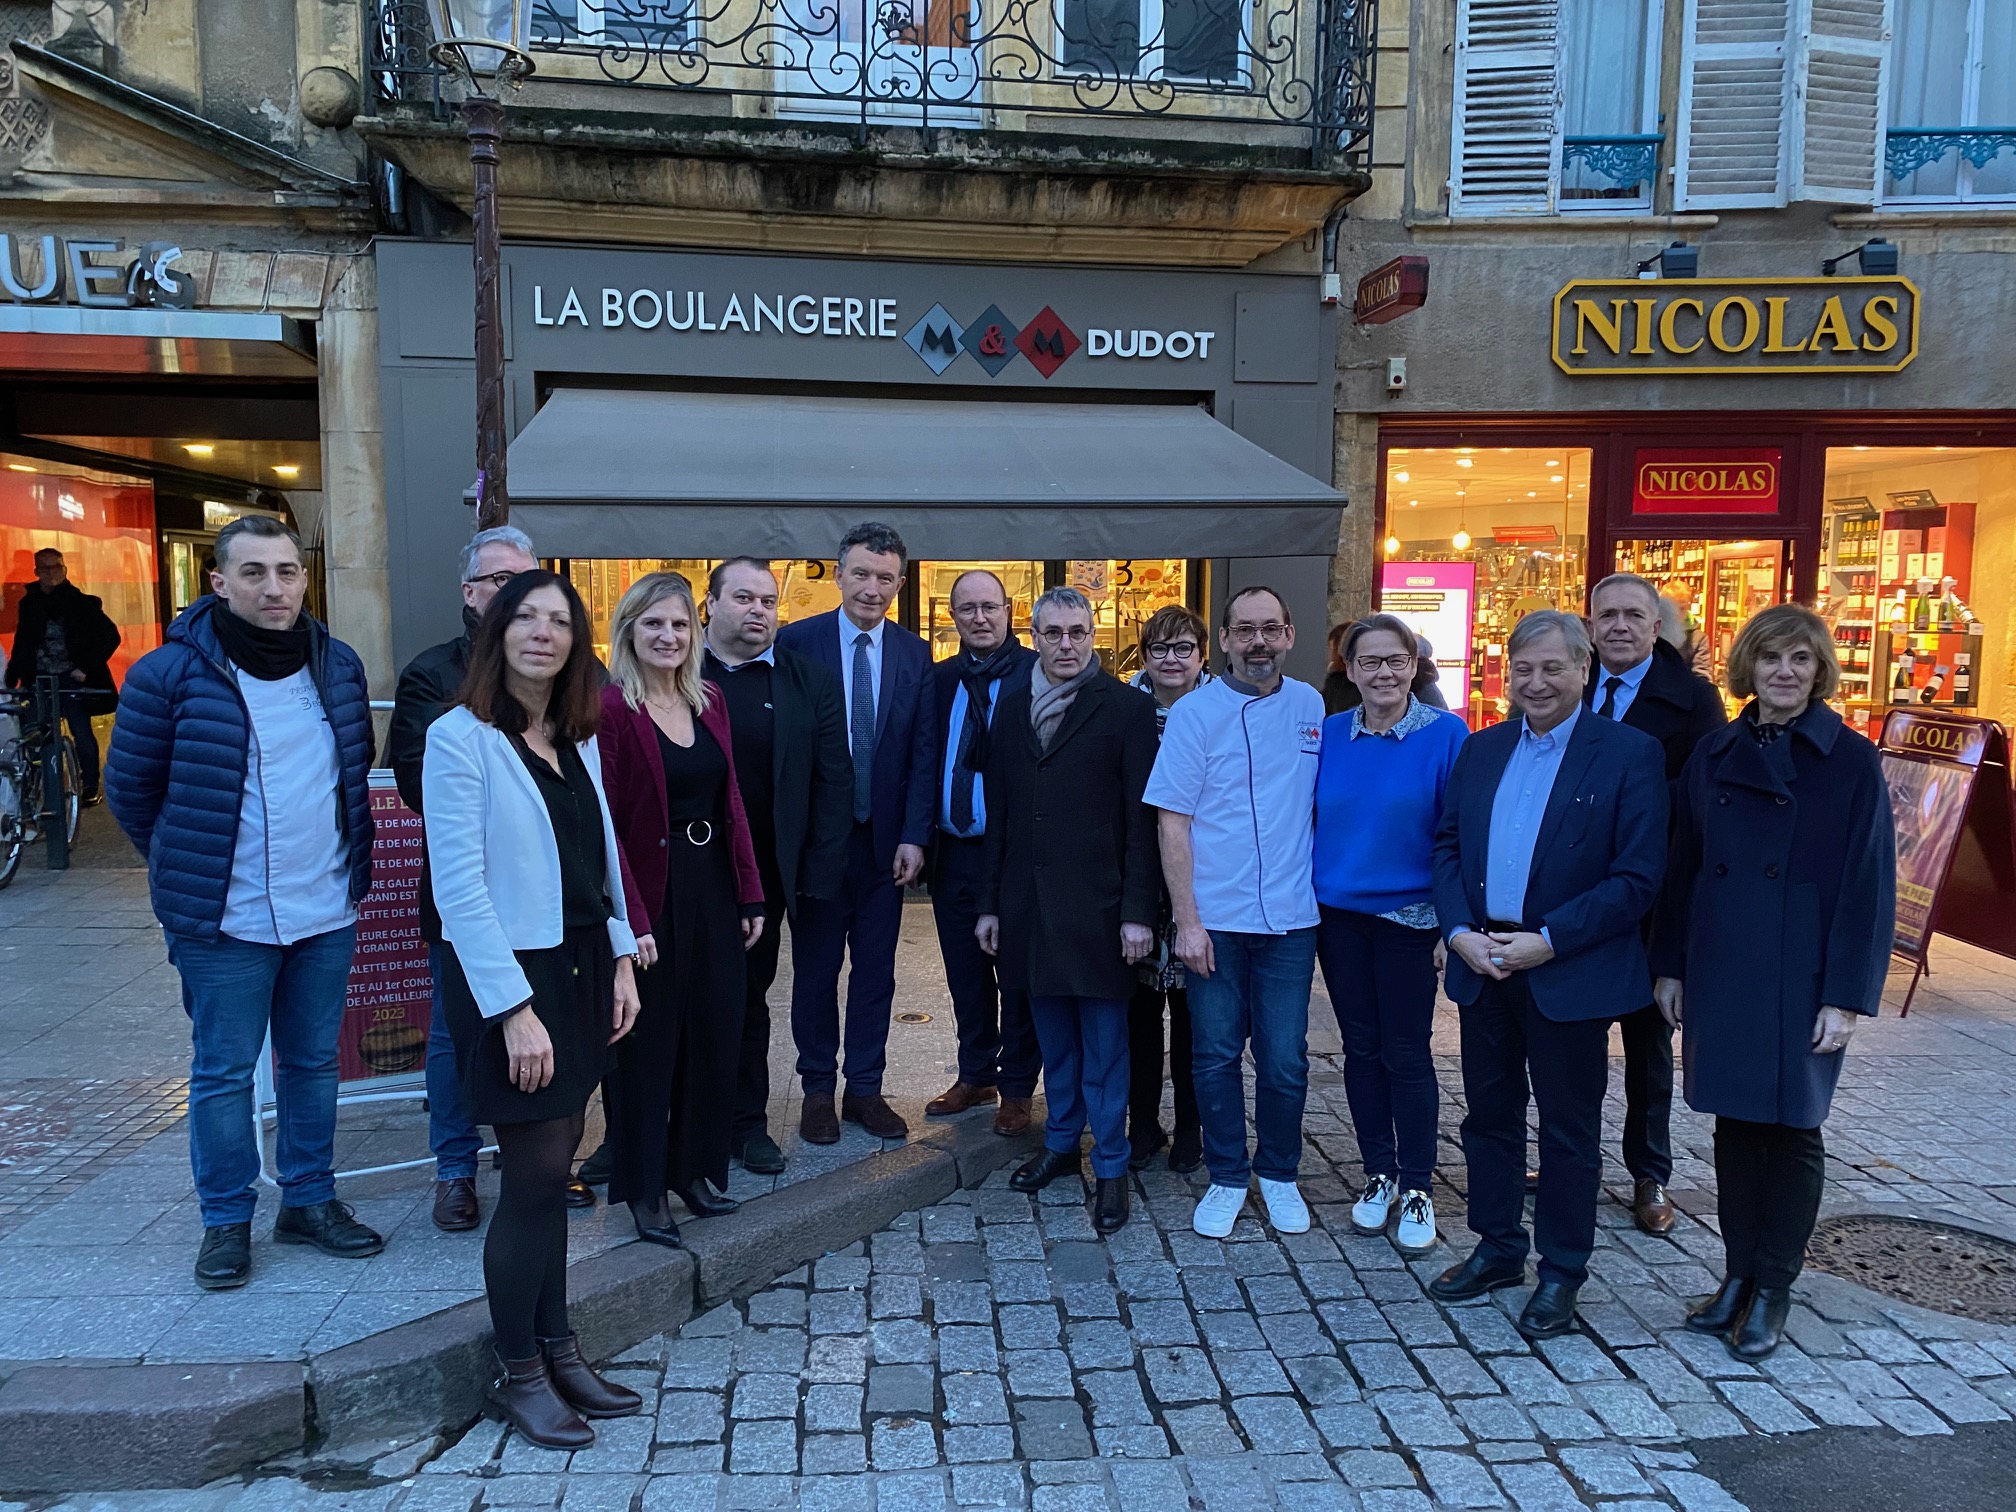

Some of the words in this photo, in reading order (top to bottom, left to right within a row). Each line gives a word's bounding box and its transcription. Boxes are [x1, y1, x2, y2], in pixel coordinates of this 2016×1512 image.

[1361, 270, 1400, 310] NICOLAS
[534, 285, 589, 327] LA
[602, 288, 897, 337] BOULANGERIE
[919, 322, 958, 355] M
[979, 323, 1007, 355] &
[1033, 328, 1066, 356] M
[1087, 328, 1216, 360] DUDOT
[1571, 295, 1899, 354] NICOLAS
[1648, 469, 1766, 492] NICOLAS
[373, 819, 383, 829] E
[385, 818, 399, 828] DE
[386, 838, 400, 848] DE
[372, 860, 387, 869] TE
[388, 859, 402, 868] DE
[371, 880, 386, 889] RE
[387, 877, 421, 888] GALET
[399, 890, 418, 900] EST
[358, 909, 390, 920] LETTE
[391, 908, 406, 918] DE
[356, 930, 389, 941] LEURE
[390, 927, 421, 938] GALET
[362, 941, 400, 953] GRAND
[401, 940, 420, 950] EST
[349, 963, 387, 974] ALETTE
[389, 961, 403, 970] DE
[346, 983, 366, 994] STE
[368, 981, 383, 991] AU
[385, 981, 400, 990] 1er
[346, 998, 361, 1007] DE
[363, 996, 377, 1005] LA
[379, 989, 434, 1003] MEILLEURE
[372, 1007, 406, 1022] 2023
